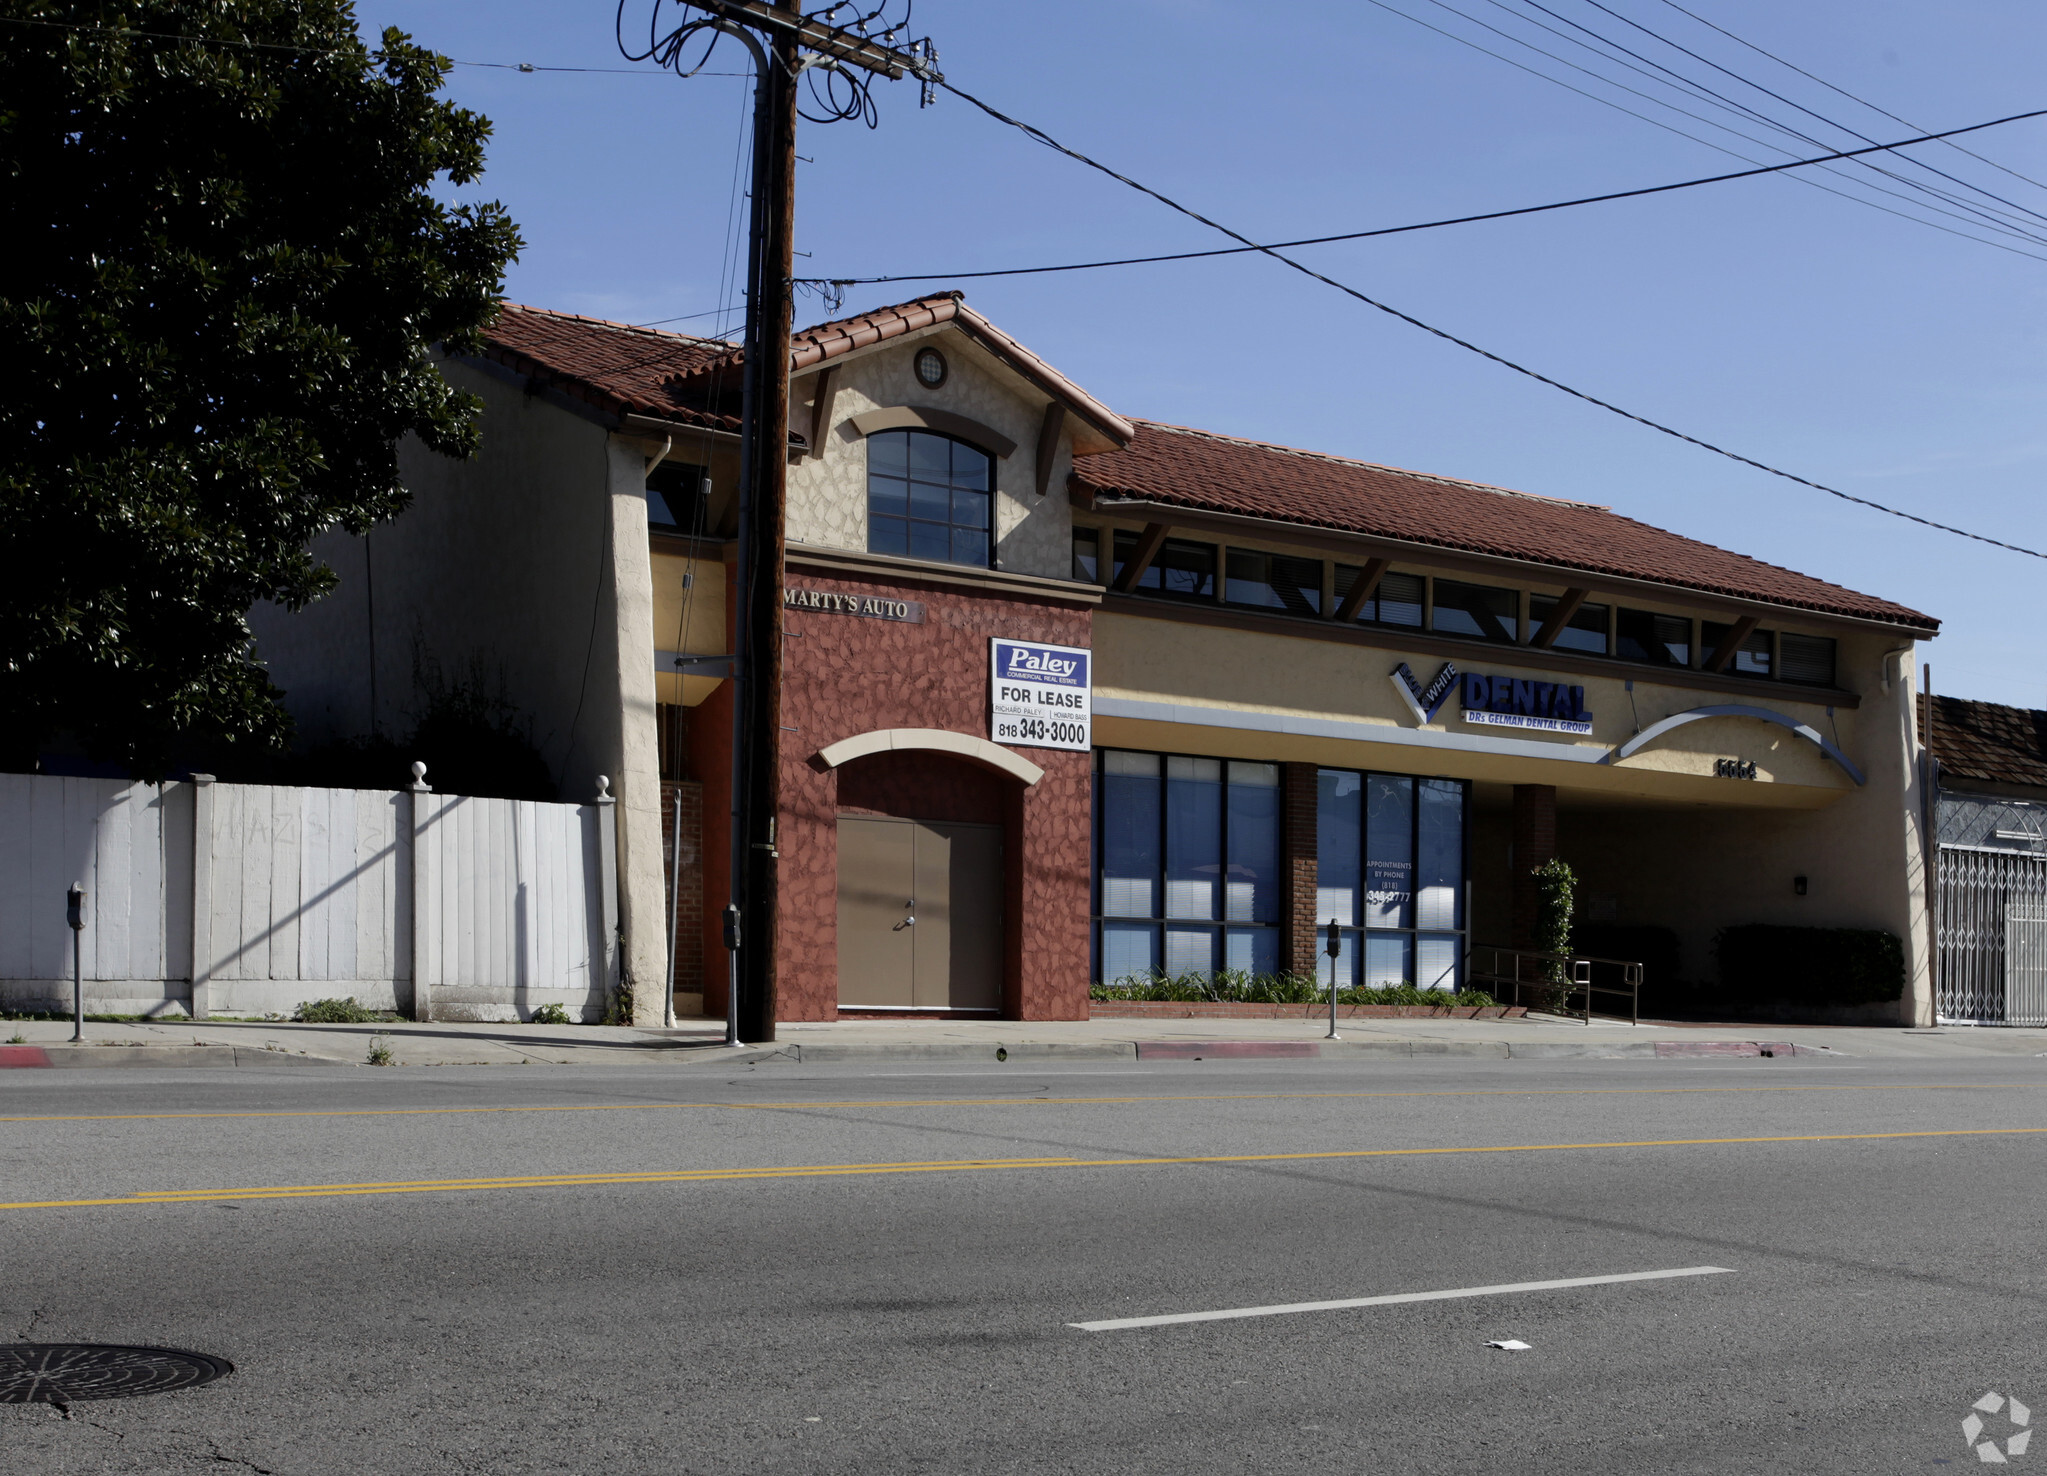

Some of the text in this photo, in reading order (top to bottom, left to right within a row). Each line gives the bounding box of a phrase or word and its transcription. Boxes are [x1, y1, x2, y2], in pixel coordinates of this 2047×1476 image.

[783, 588, 908, 618] MARTY'S AUTO
[1008, 648, 1077, 677] Paley
[1006, 672, 1043, 681] COMMERCIAL
[1059, 677, 1078, 685] ESTATE
[1426, 661, 1458, 703] WHITE
[1001, 686, 1083, 709] FOR LEASE
[1461, 672, 1593, 722] DENTAL
[994, 705, 1042, 716] RICHARD PALEY
[1053, 711, 1088, 721] HOWARD BASS
[998, 718, 1085, 744] 818 343-3000
[1488, 713, 1524, 727] GELMAN
[1526, 716, 1558, 730] DENTAL
[1560, 720, 1590, 733] GROUP
[1366, 861, 1412, 869] APPOINTMENTS
[1374, 870, 1405, 879] BY PHONE
[1381, 881, 1398, 890] (818)
